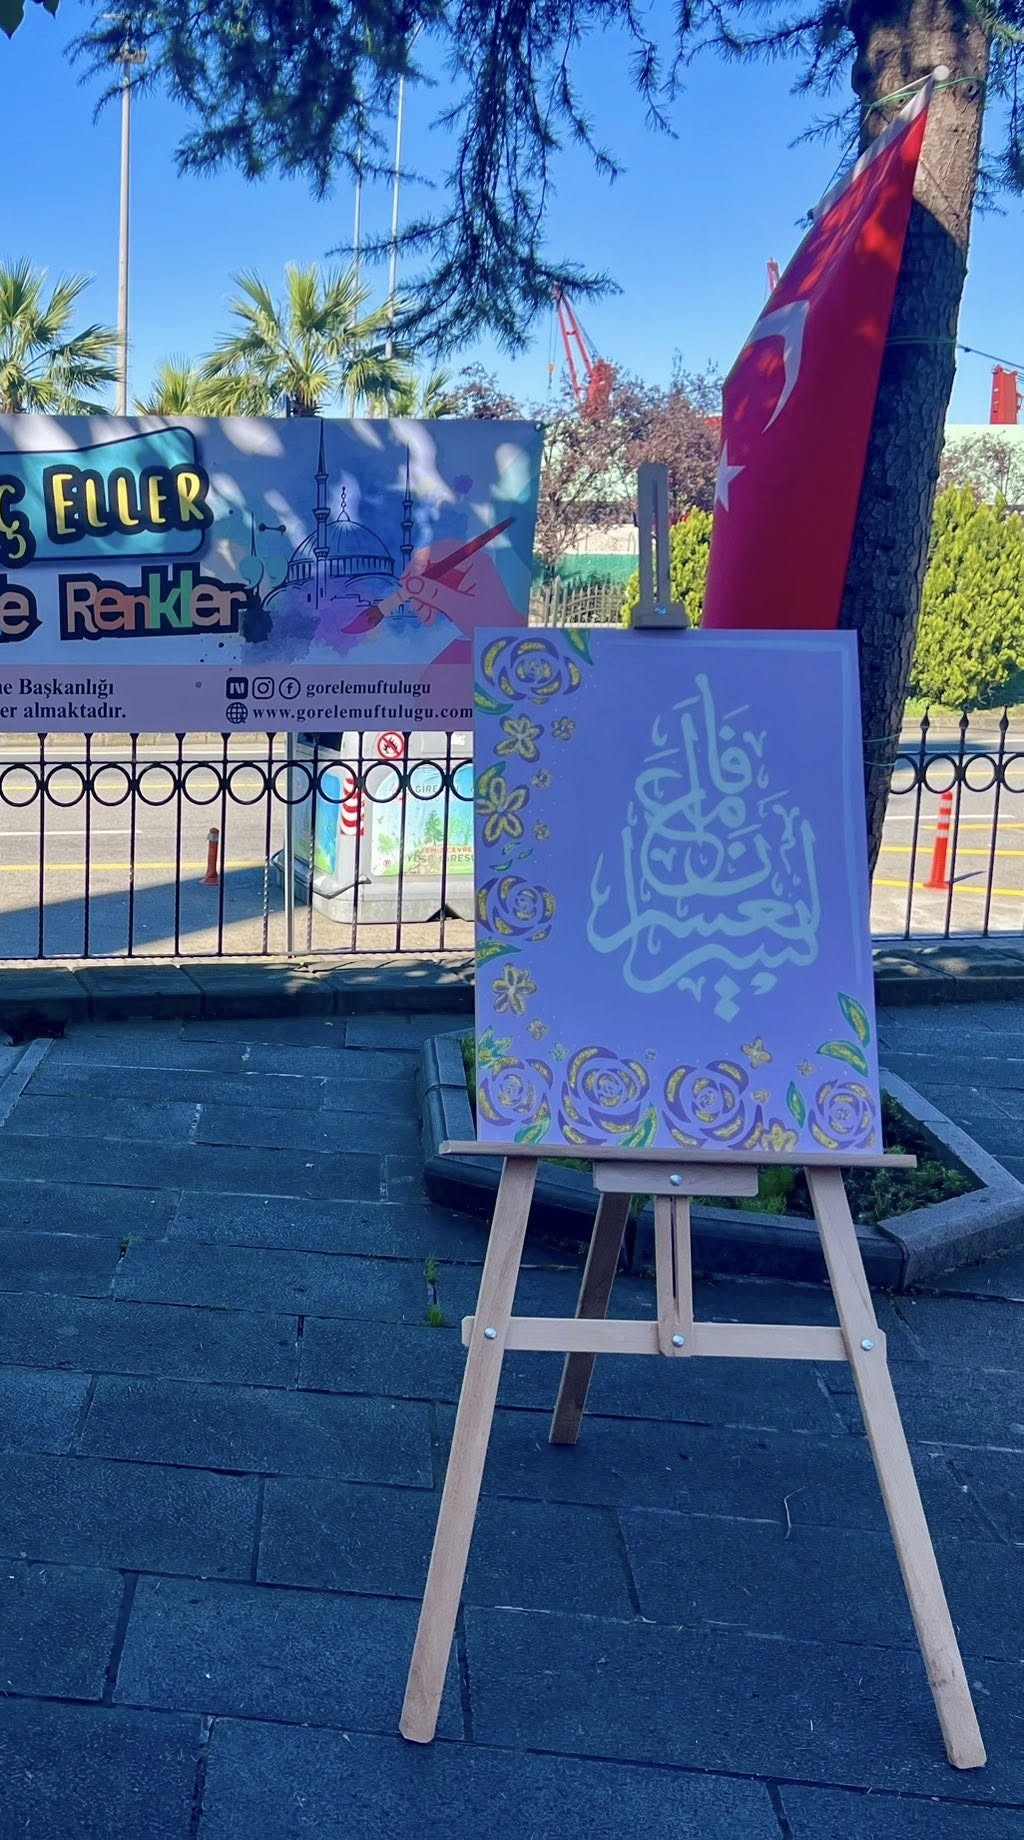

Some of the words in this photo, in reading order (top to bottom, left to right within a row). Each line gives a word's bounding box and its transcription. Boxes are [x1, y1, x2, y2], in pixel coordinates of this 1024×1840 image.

[51, 472, 205, 536] ELLER
[19, 678, 114, 699] Başkanlığı
[306, 680, 431, 700] gorelemuftulugu
[23, 701, 127, 719] almaktadır.
[252, 704, 473, 722] www.gorelemuftulugu.com
